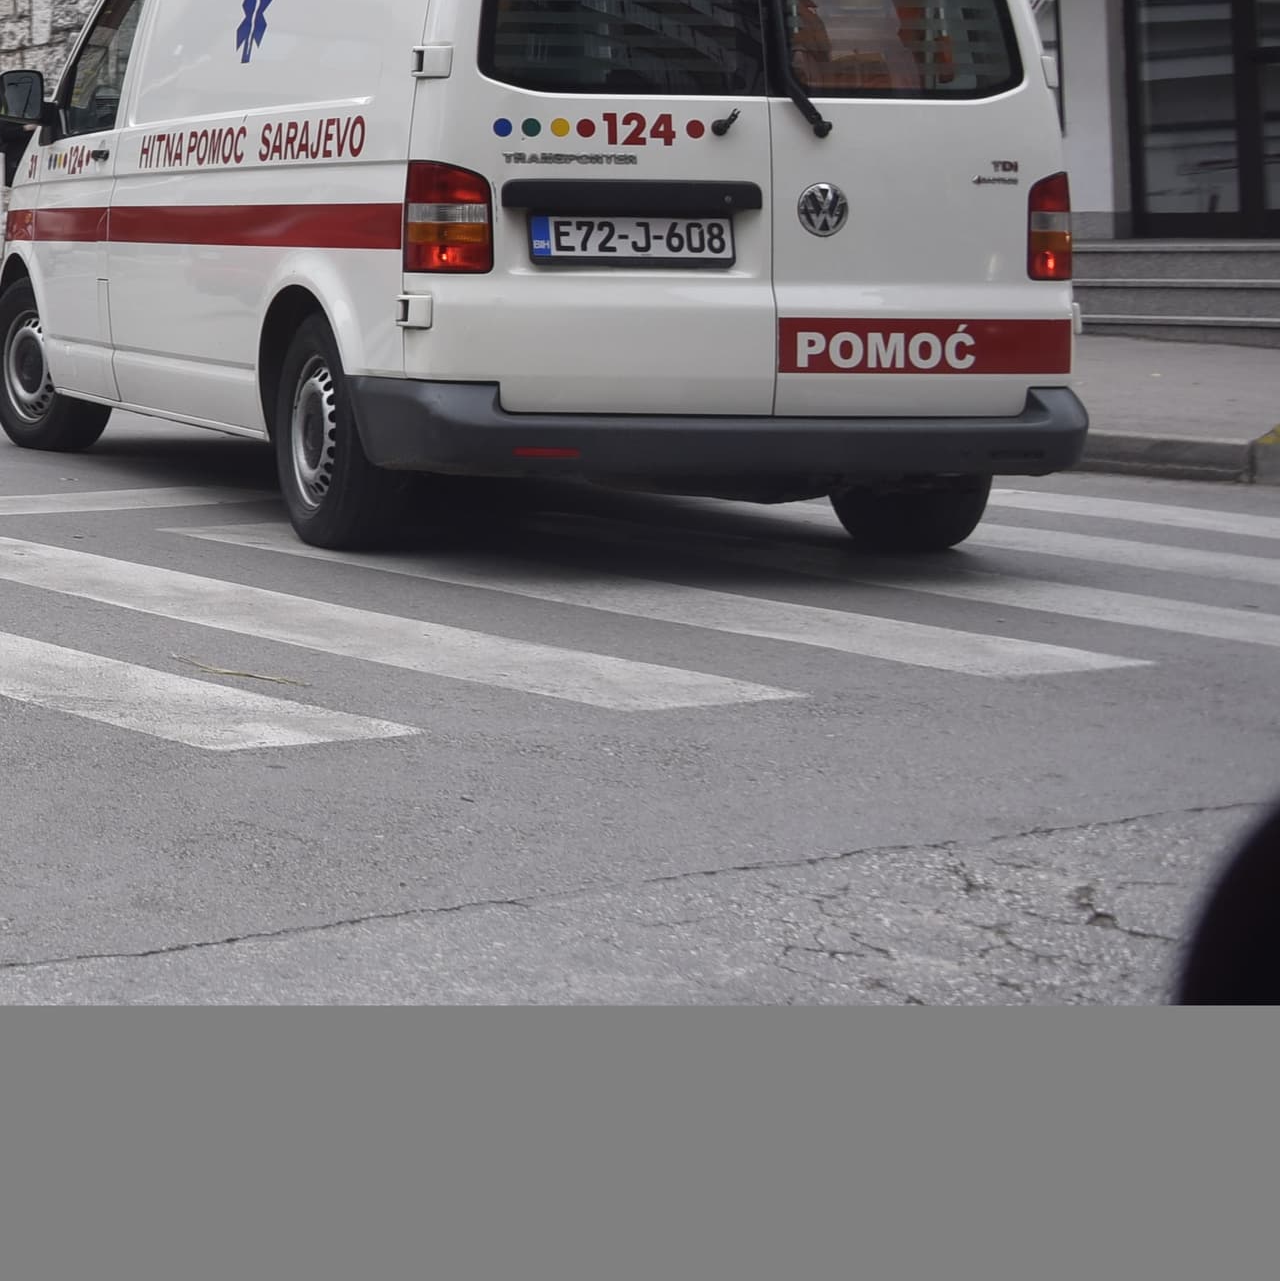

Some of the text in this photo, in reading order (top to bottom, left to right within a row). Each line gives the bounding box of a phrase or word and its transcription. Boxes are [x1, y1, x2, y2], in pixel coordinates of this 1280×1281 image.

[138, 114, 366, 169] HITNA POMOĆ SARAJEVO
[602, 112, 676, 147] 124
[67, 144, 86, 175] 124
[502, 152, 638, 166] TRANSPORTER
[991, 159, 1019, 173] TDI
[532, 220, 727, 255] BIH E72-J-608
[796, 323, 977, 370] POMOĆ
